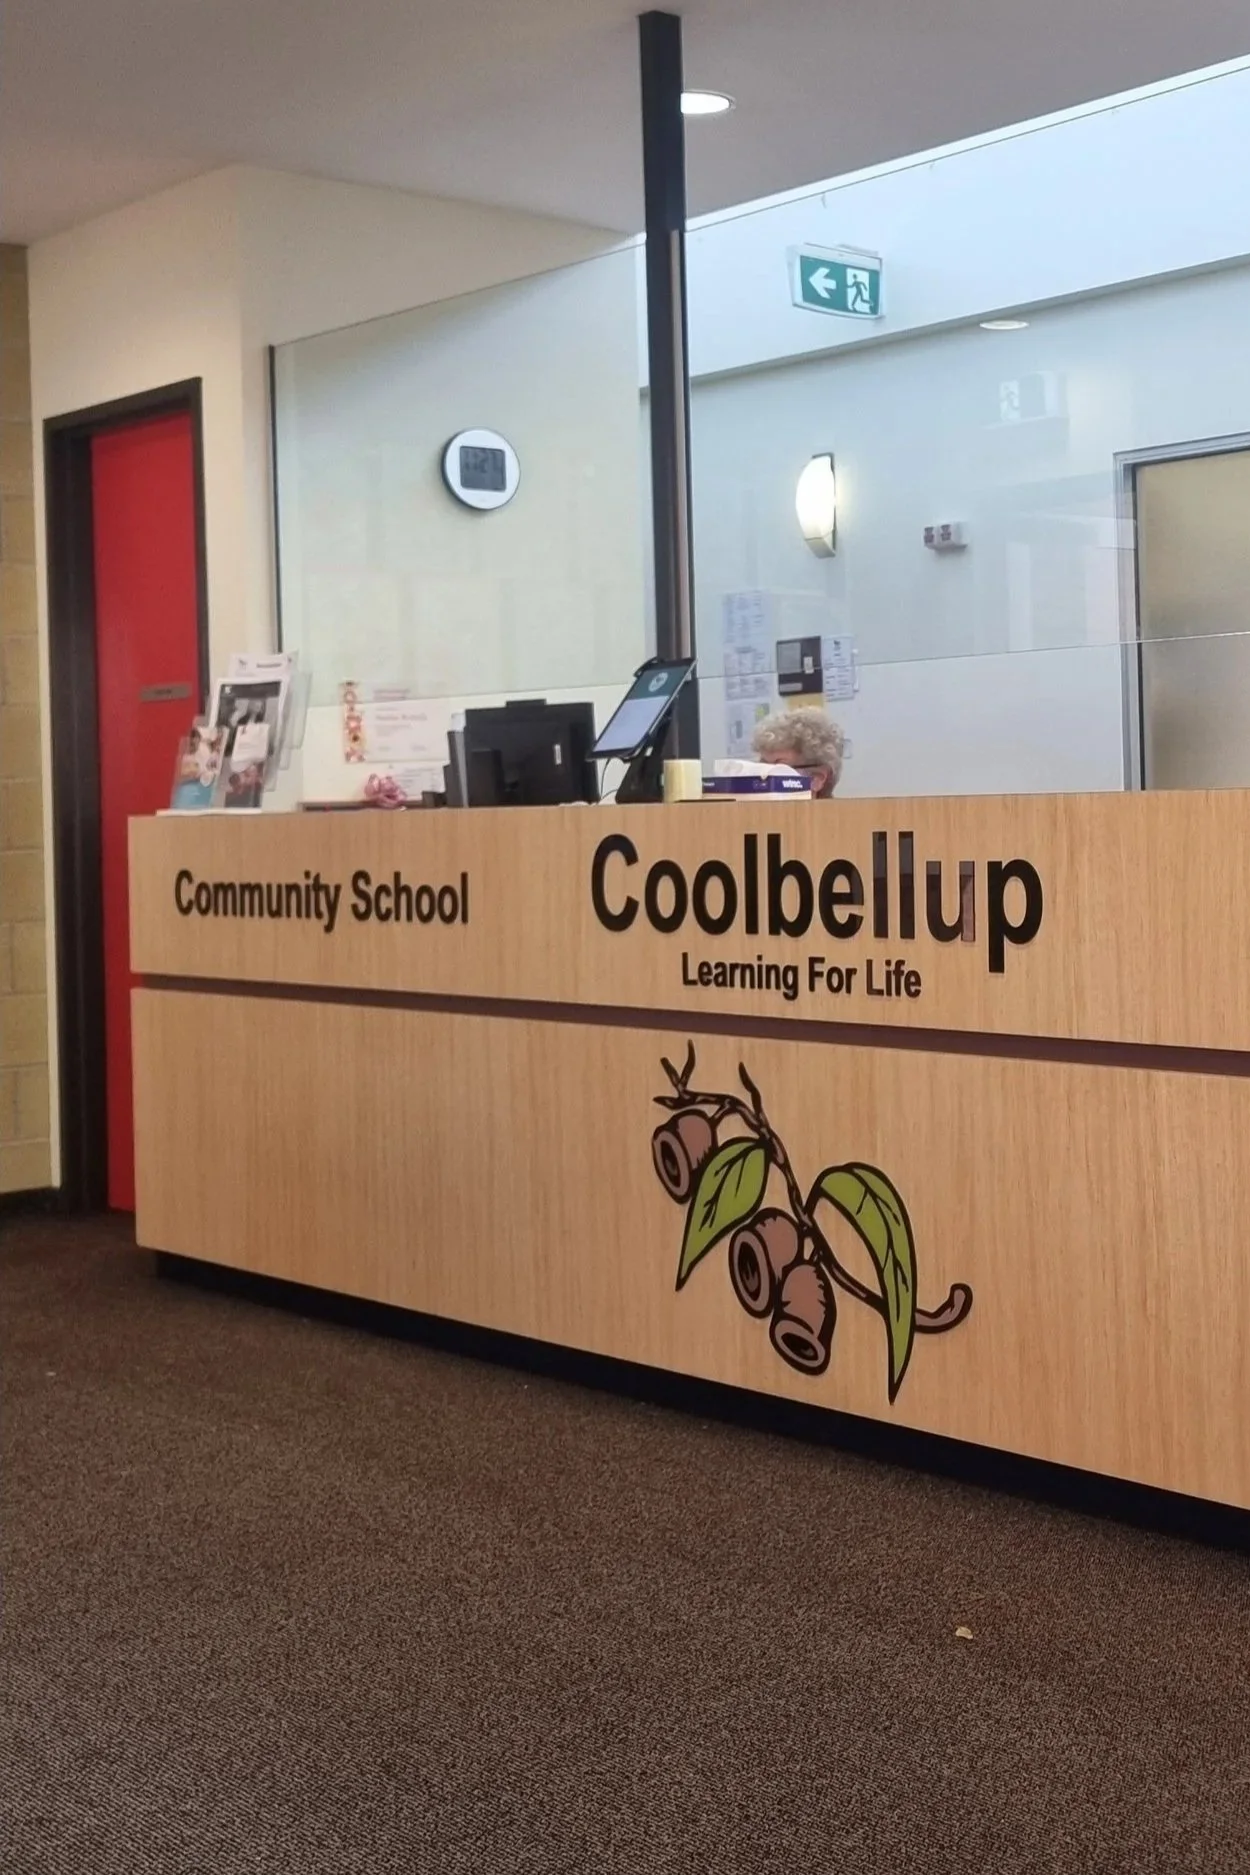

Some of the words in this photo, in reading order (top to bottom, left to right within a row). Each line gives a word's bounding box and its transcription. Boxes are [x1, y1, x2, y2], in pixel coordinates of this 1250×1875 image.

[174, 869, 342, 934] Community
[351, 869, 469, 925] School
[591, 830, 1043, 974] Coolbellup
[682, 951, 799, 1002] Learning
[808, 956, 858, 995] For
[866, 959, 922, 999] Life
